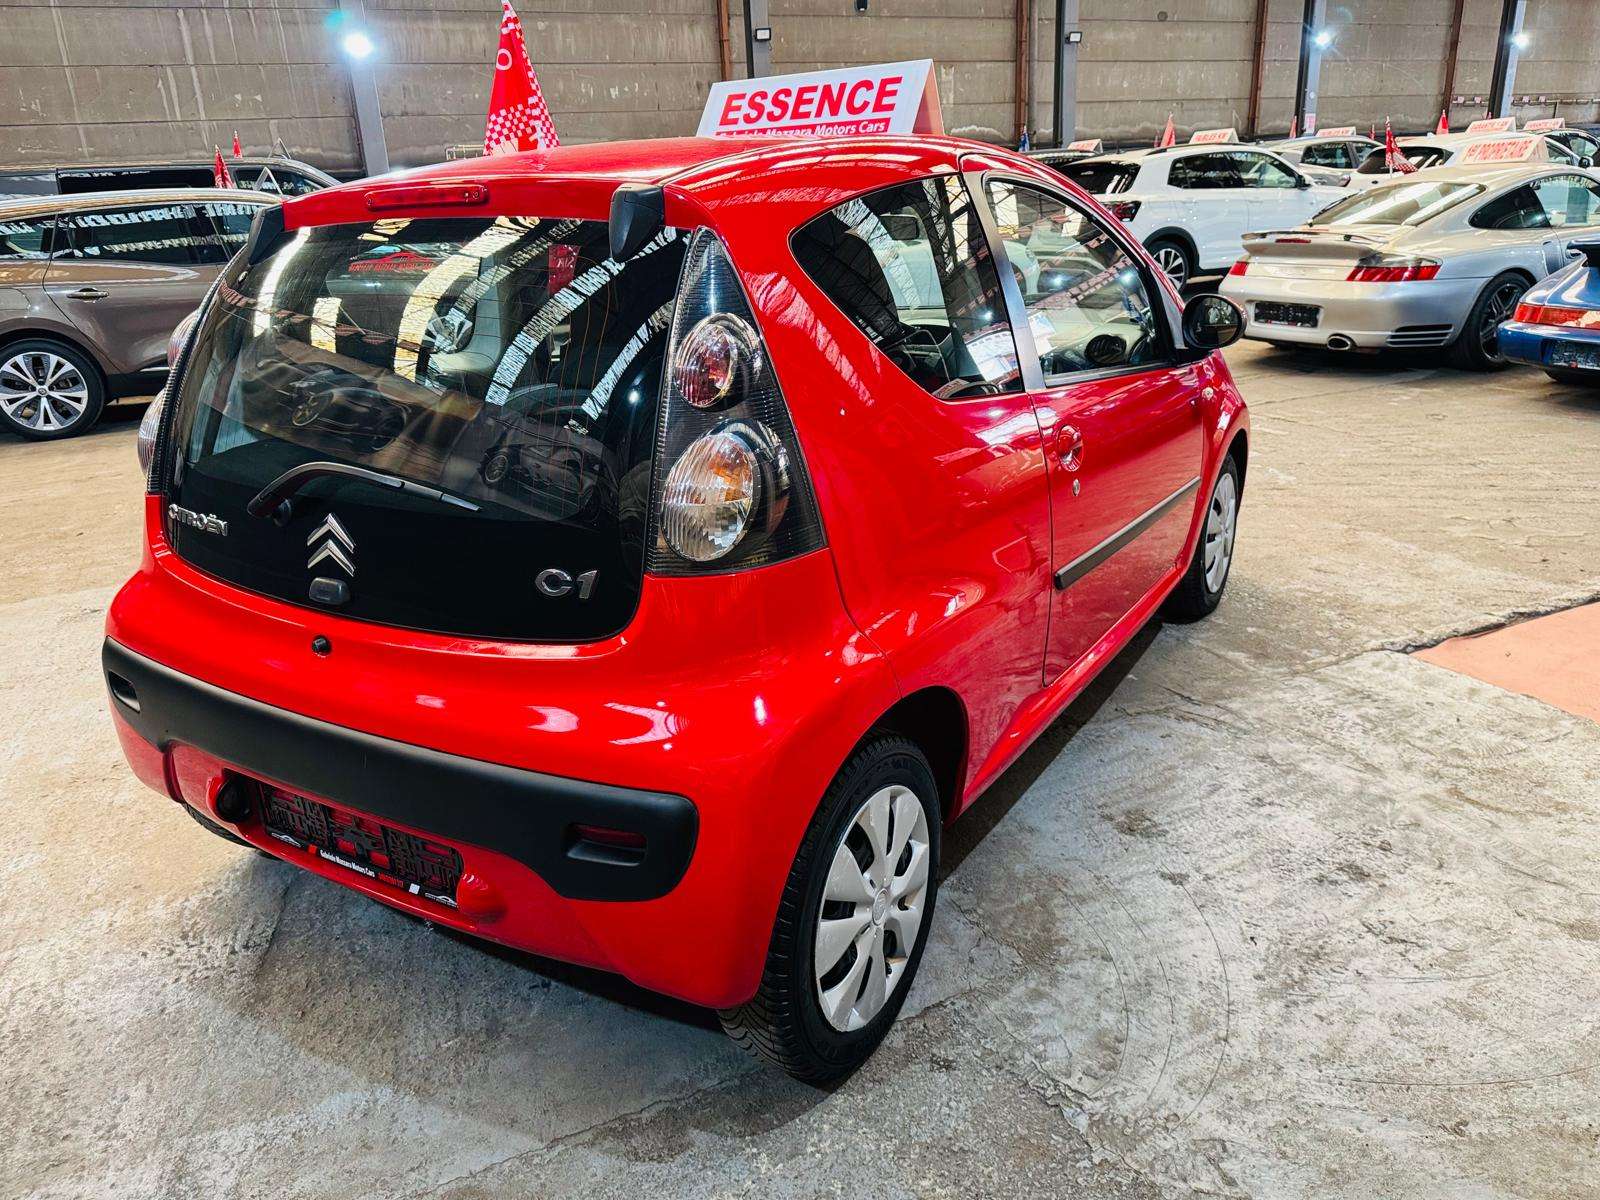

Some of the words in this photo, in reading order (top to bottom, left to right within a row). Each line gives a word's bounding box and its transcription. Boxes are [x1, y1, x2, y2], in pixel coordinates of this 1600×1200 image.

[718, 76, 903, 126] ESSENCE
[814, 124, 857, 137] Motors
[858, 121, 885, 134] Cars
[535, 568, 598, 599] C1
